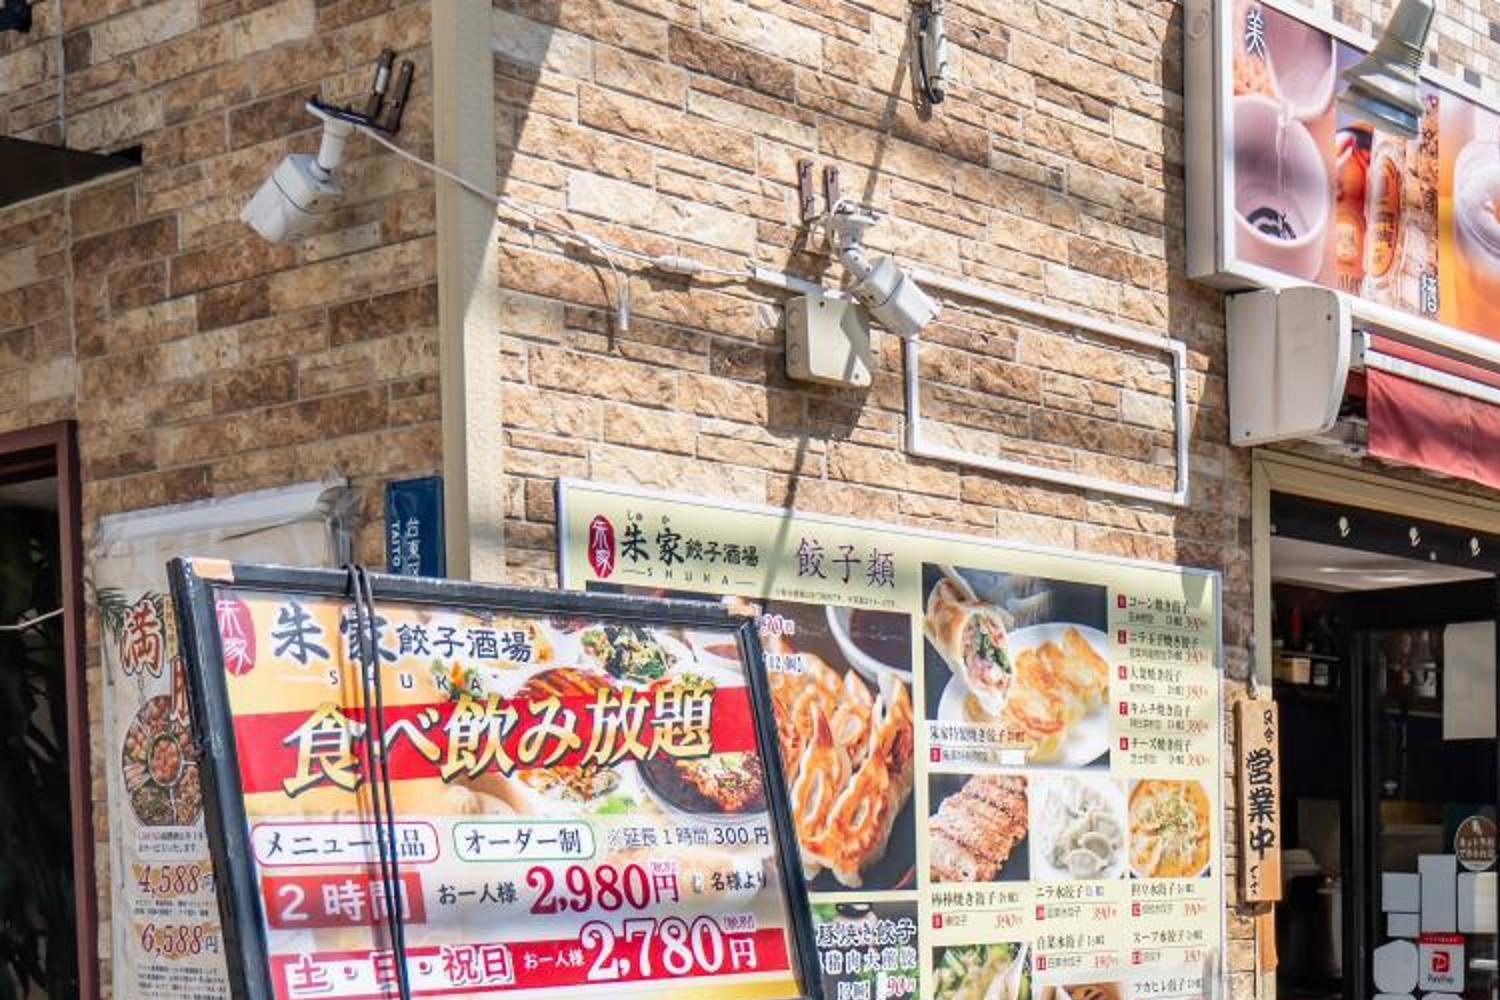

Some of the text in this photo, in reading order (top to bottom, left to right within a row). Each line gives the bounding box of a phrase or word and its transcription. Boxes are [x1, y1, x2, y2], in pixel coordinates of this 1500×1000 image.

[392, 522, 401, 567] TAITO
[798, 537, 897, 589] 餃子類
[328, 668, 484, 692] SUKA
[282, 682, 716, 798] 食べ飲み放題
[1247, 748, 1276, 861] 営業中
[266, 828, 425, 858] メニュー品
[465, 826, 581, 855] オーダー制
[438, 885, 519, 906] お一人様
[523, 948, 588, 971] お一人様
